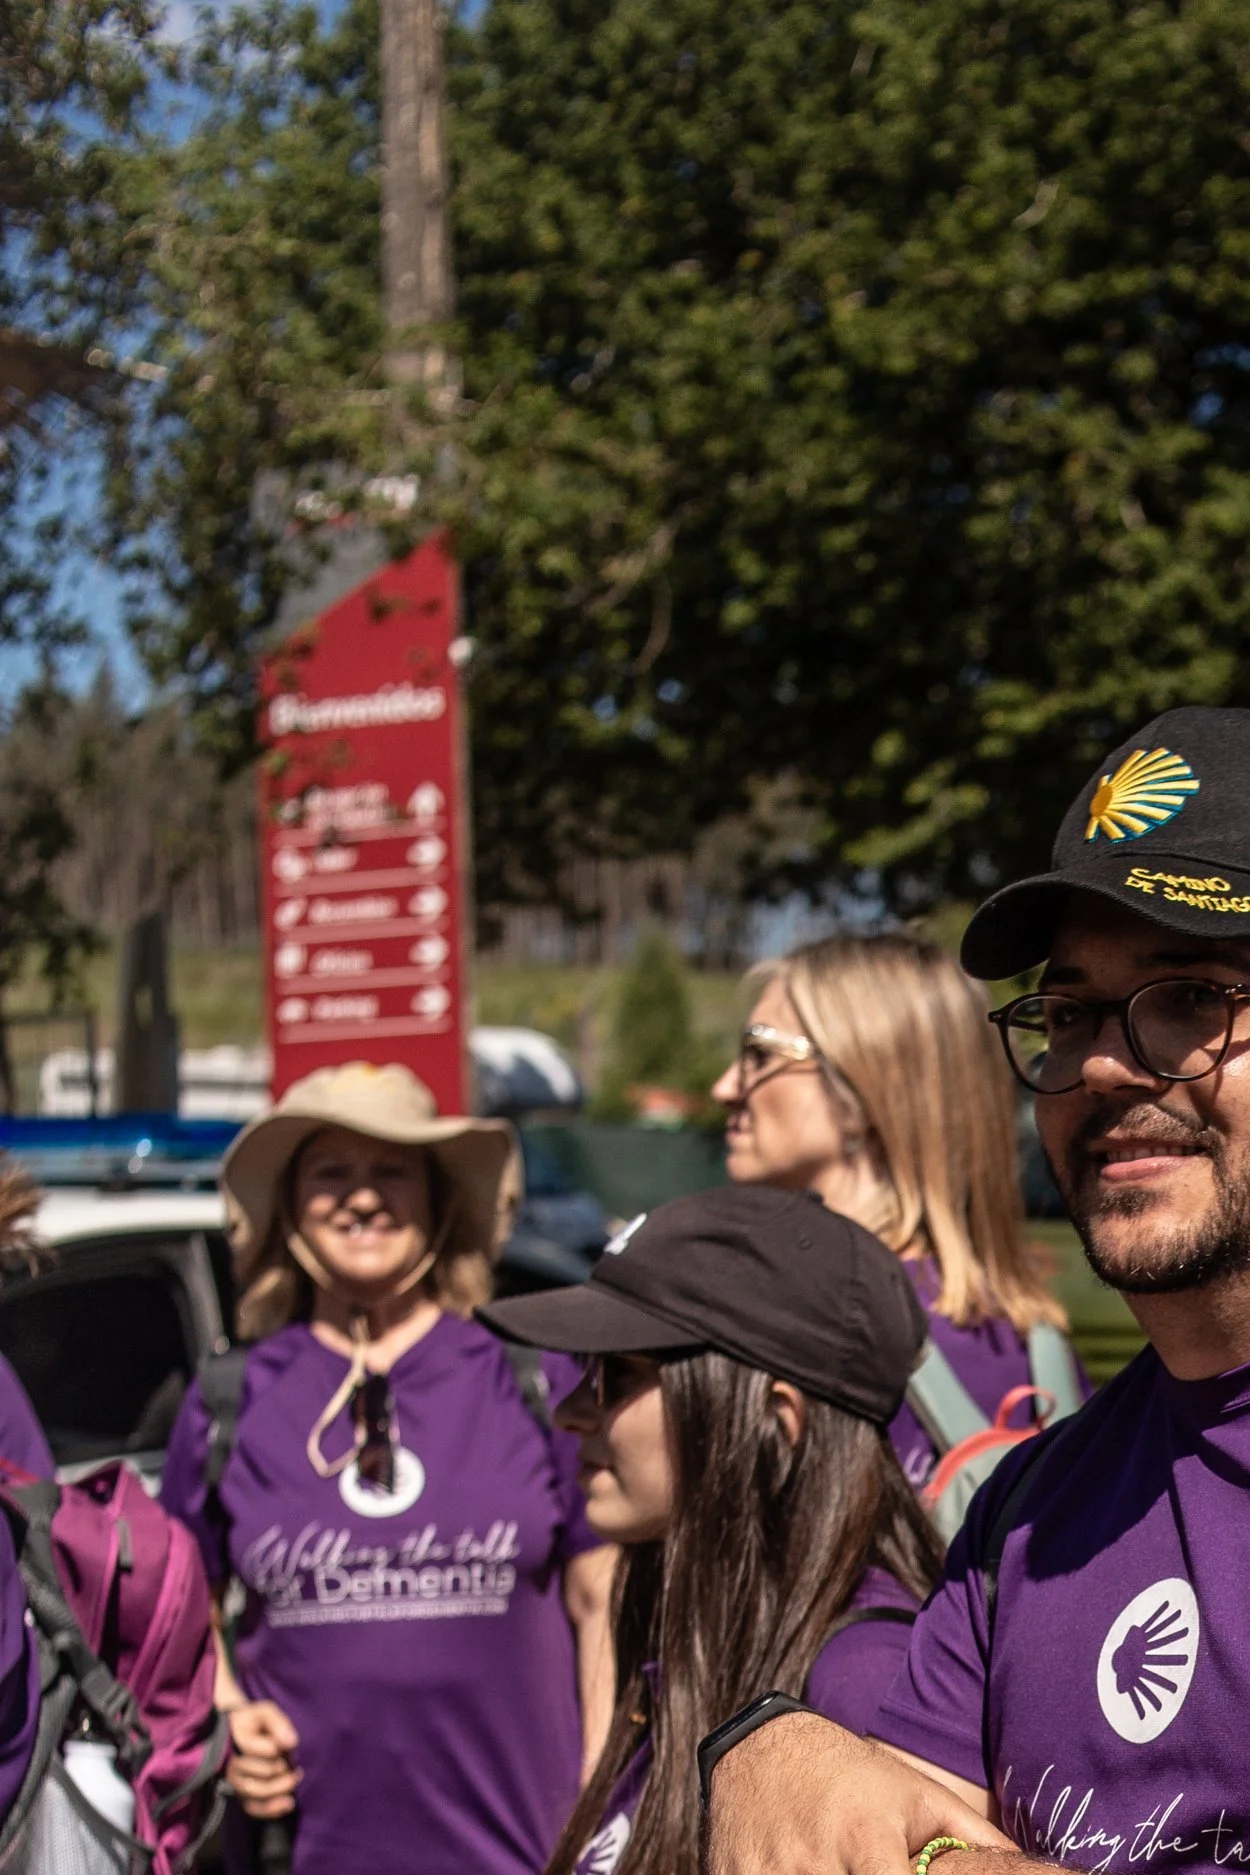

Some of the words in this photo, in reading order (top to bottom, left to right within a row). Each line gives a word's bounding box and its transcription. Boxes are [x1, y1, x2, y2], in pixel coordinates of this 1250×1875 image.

[1125, 876, 1155, 894] DE
[1130, 867, 1232, 892] CAMINO
[314, 1561, 516, 1604] Dementia
[1128, 1792, 1198, 1862] the
